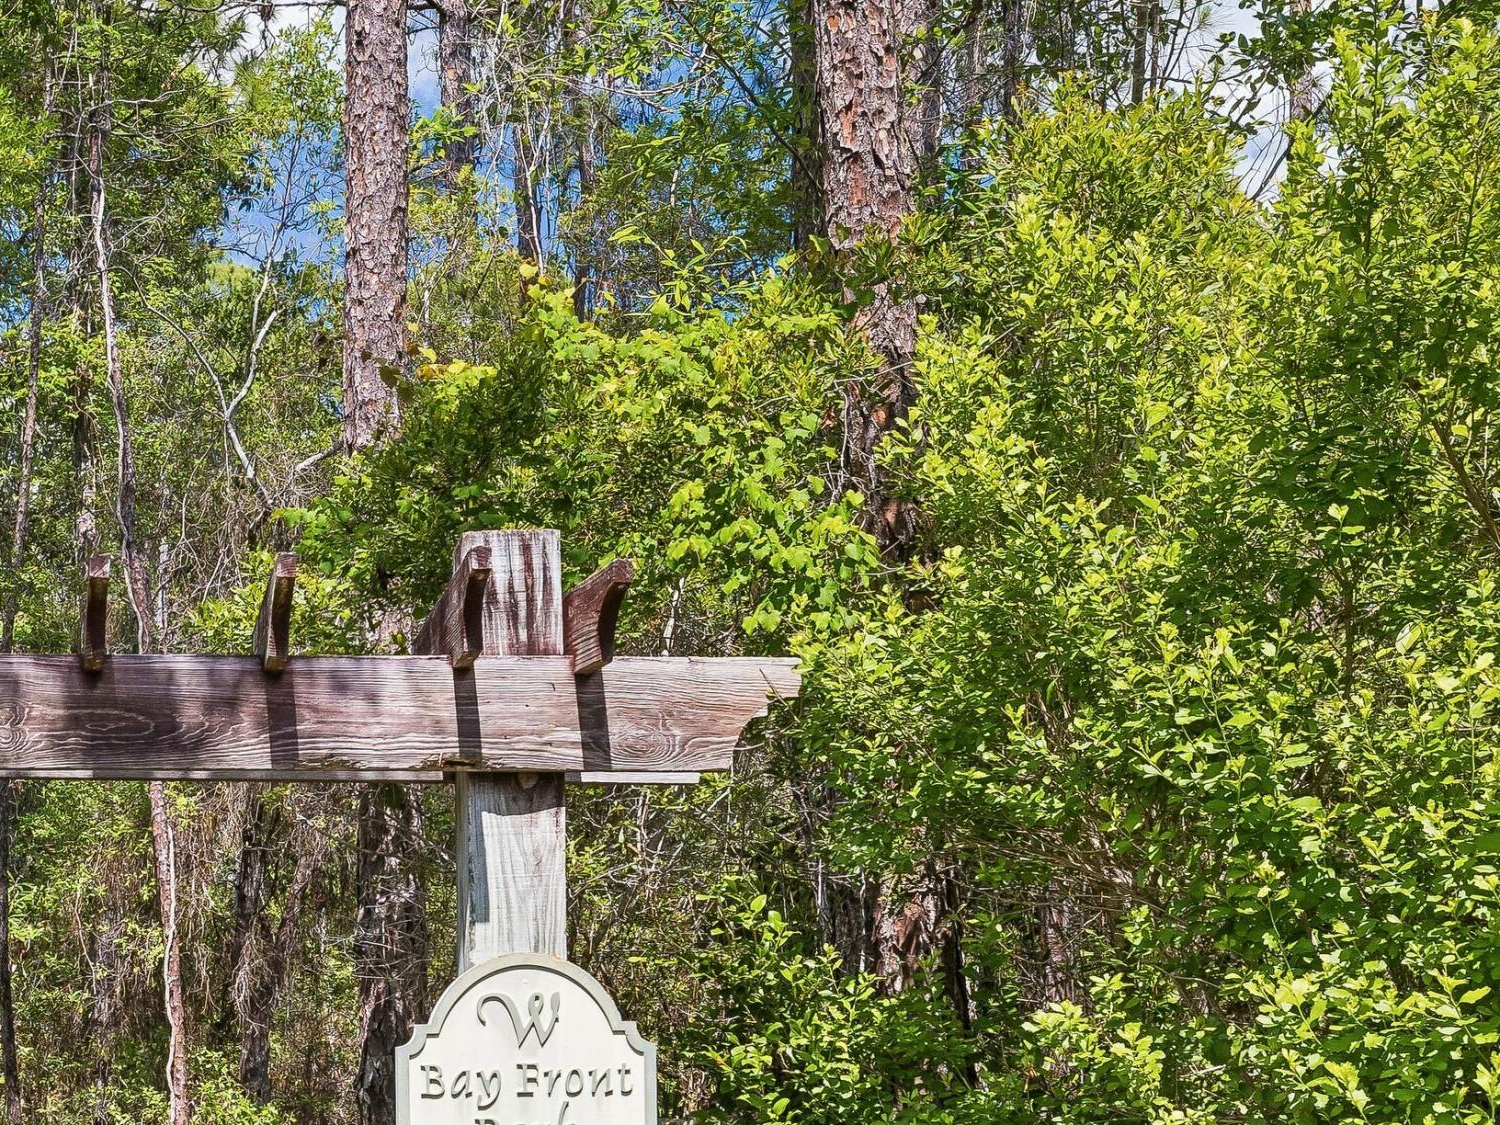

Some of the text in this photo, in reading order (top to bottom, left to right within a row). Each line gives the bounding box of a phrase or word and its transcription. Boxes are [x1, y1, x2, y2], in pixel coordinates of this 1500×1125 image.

[476, 991, 561, 1050] W
[420, 1063, 634, 1111] Bay Front
